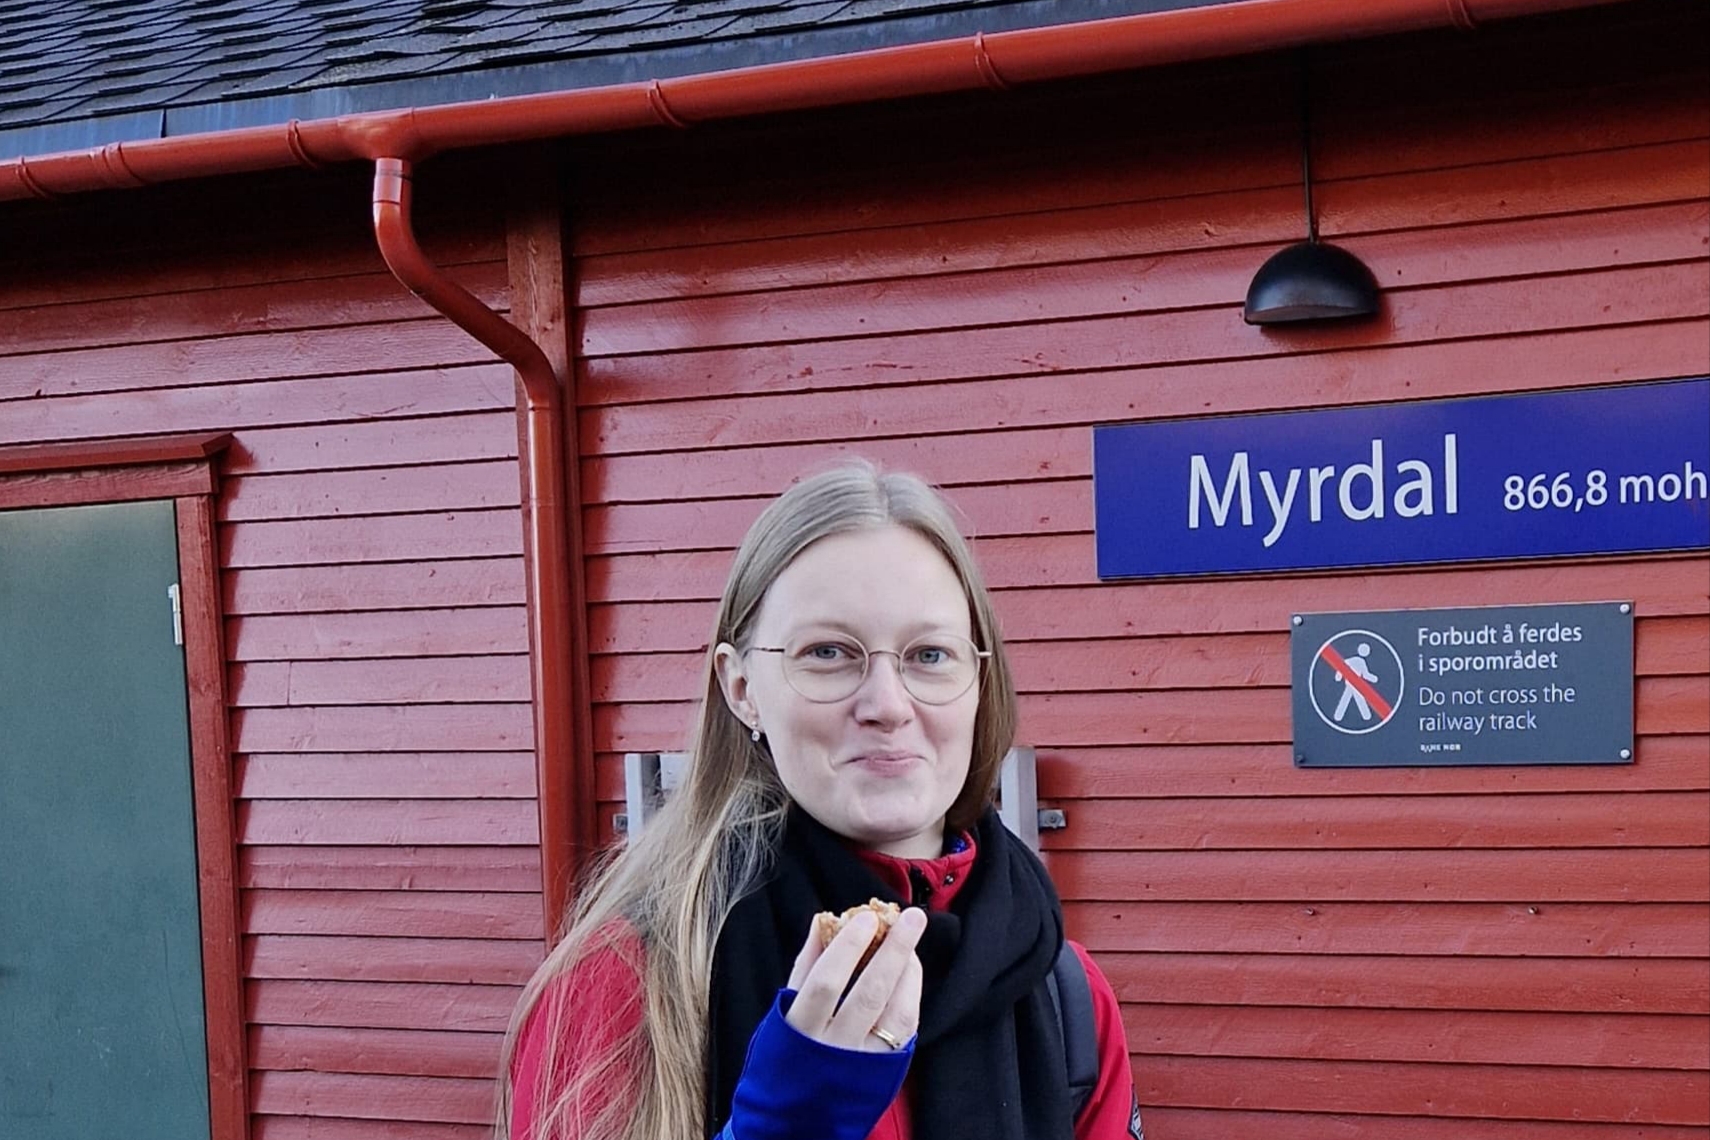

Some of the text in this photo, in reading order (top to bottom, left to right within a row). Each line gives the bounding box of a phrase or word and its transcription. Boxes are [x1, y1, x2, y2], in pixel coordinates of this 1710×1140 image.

[1188, 433, 1706, 548] Myrdal 866,8 moh
[1418, 622, 1582, 646] Forbudt å ferdes
[1418, 649, 1558, 676] i sporområdet
[1419, 683, 1575, 706] Do not cross the
[1419, 710, 1537, 735] railway track
